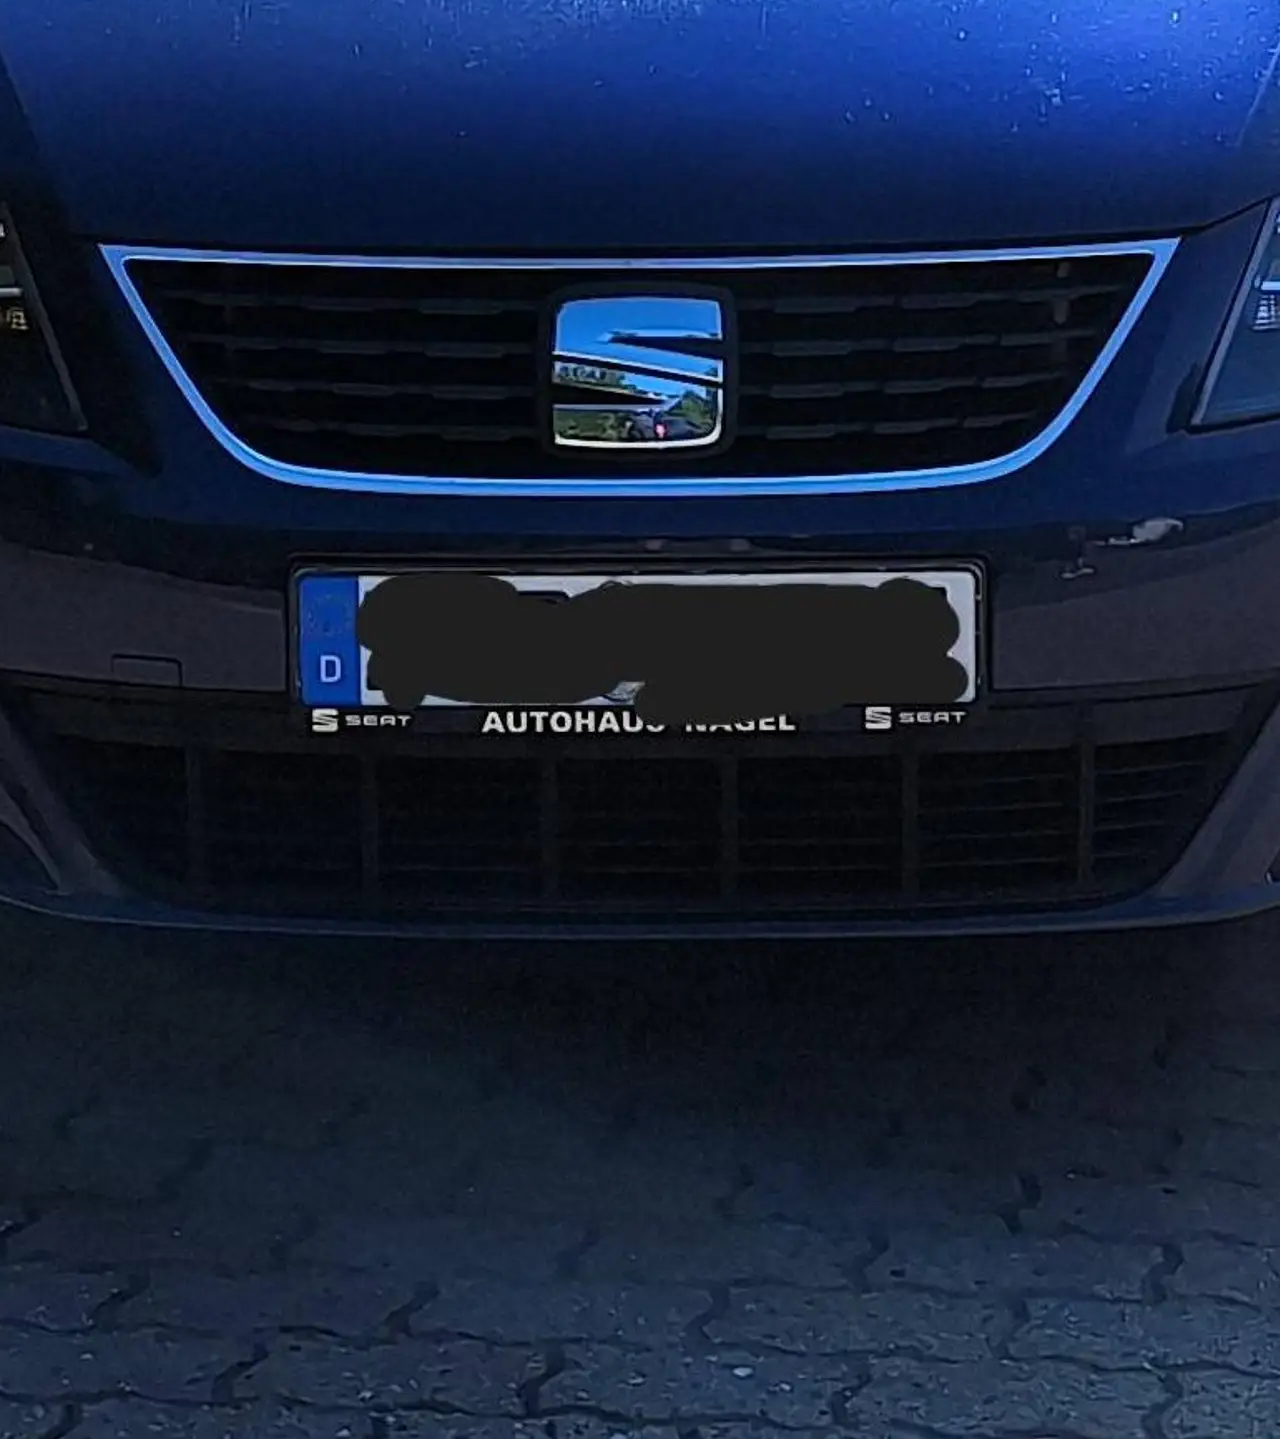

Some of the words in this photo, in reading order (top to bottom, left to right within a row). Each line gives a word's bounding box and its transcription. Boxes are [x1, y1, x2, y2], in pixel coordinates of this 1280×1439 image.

[319, 654, 342, 683] D
[344, 714, 413, 728] SEAT
[898, 711, 967, 724] SEAT
